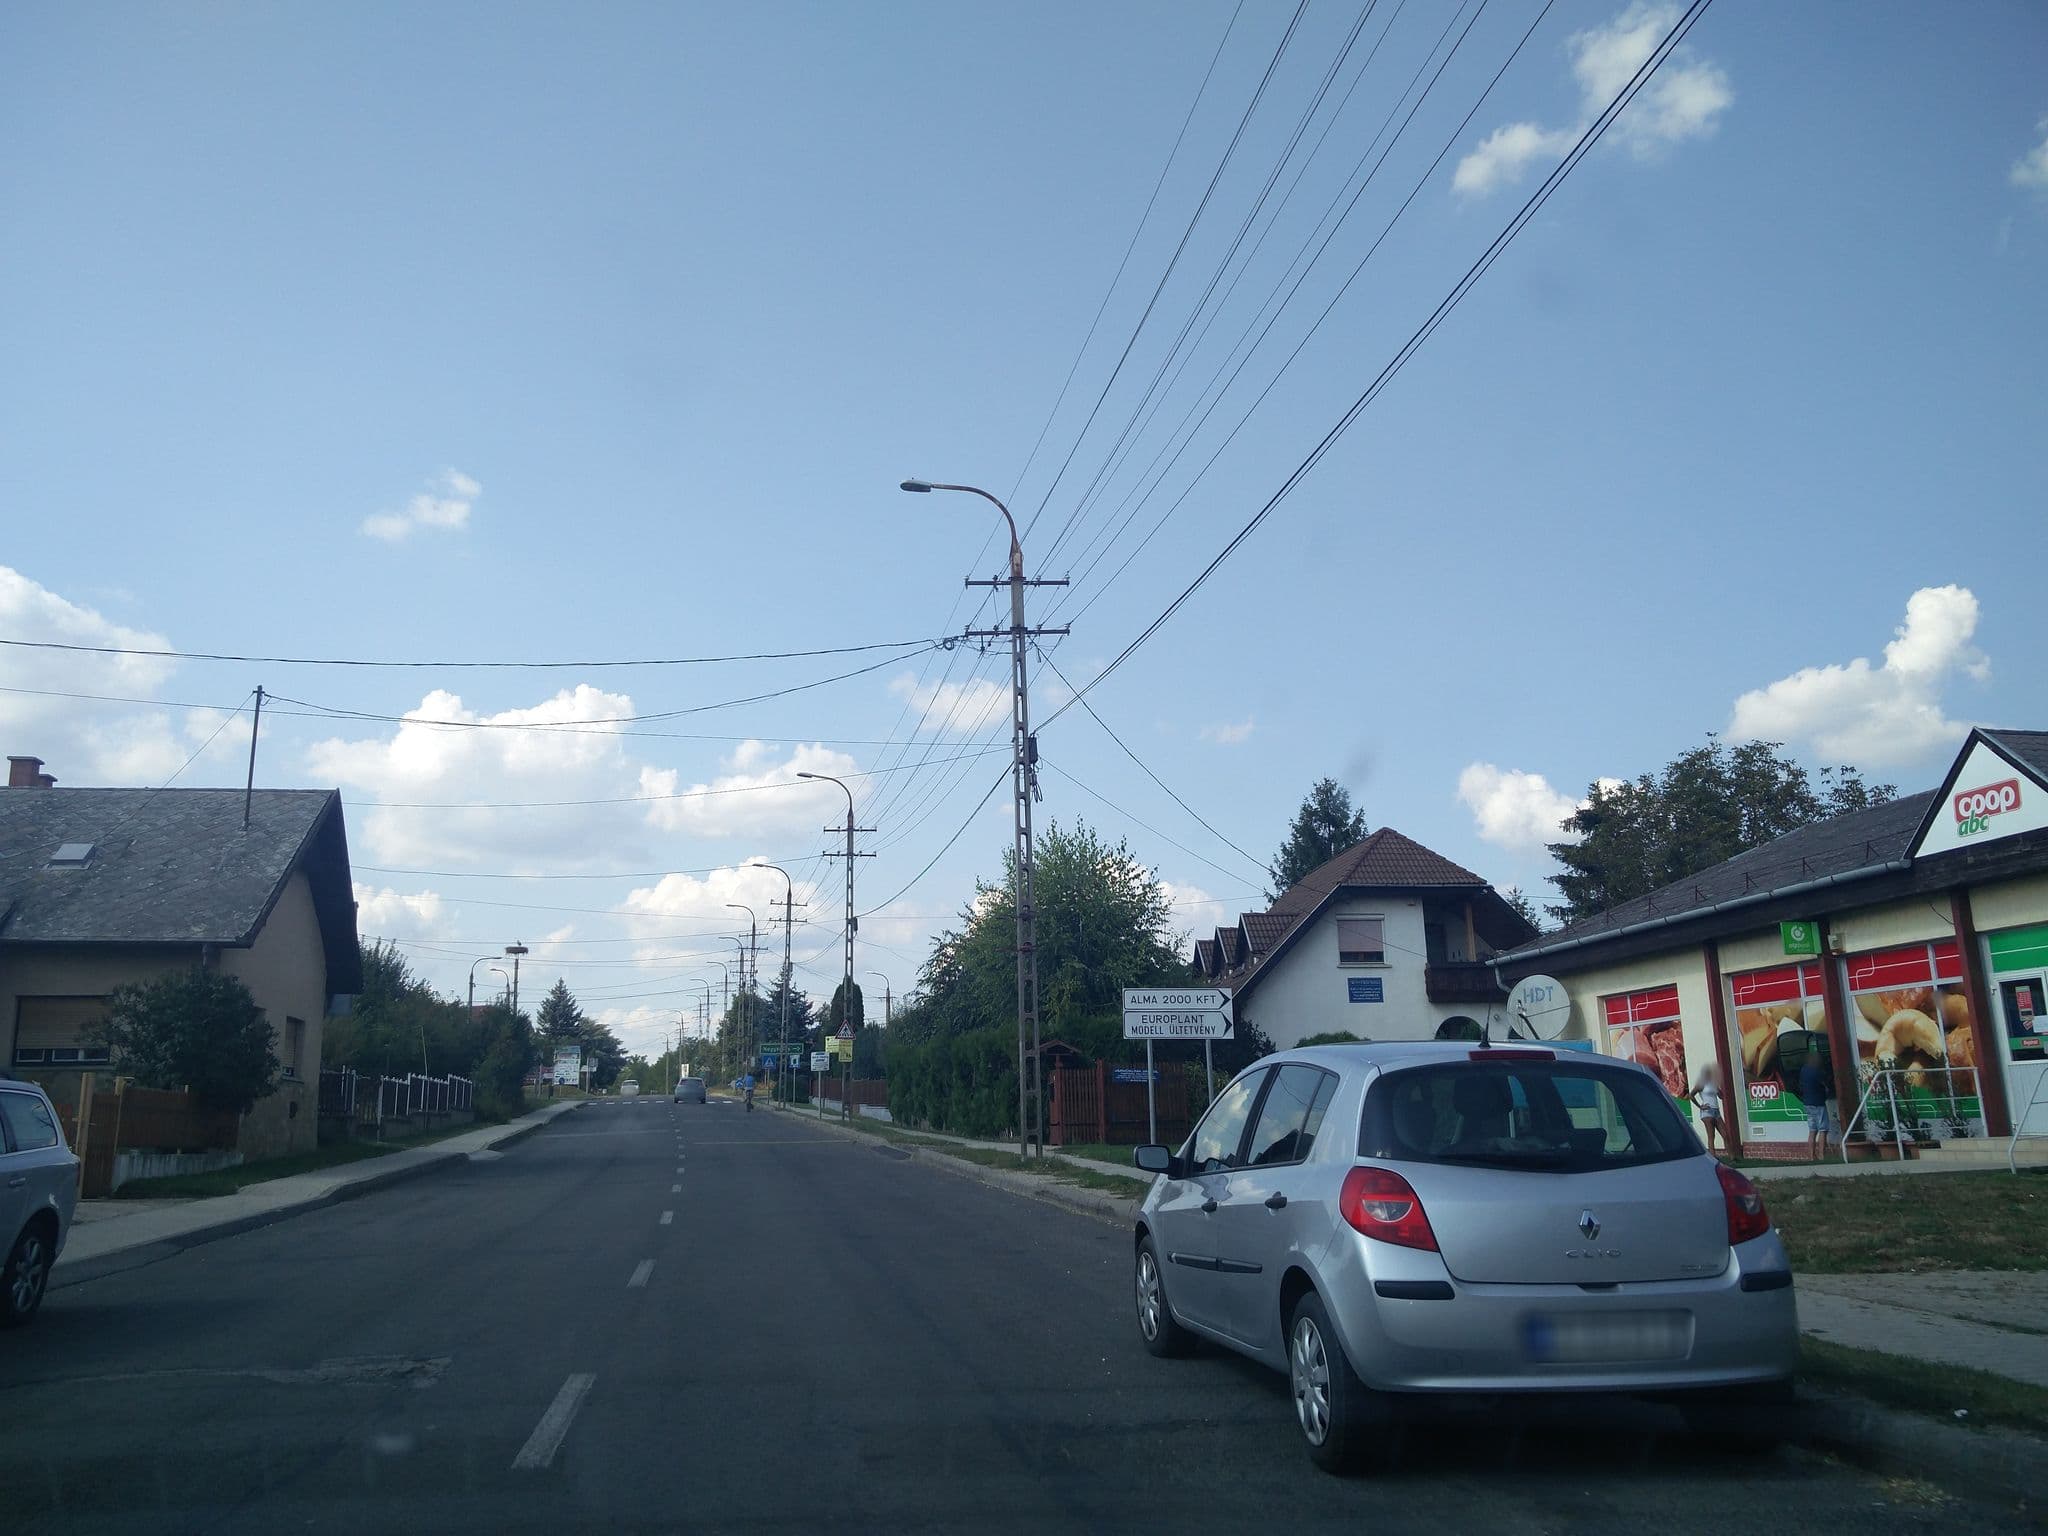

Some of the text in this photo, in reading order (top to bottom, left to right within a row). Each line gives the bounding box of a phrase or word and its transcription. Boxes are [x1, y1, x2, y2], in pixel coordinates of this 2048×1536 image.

[1958, 786, 2016, 817] coop
[1958, 809, 1989, 836] abc
[1130, 995, 1217, 1004] ALMA 2000 KFT
[1523, 986, 1553, 1003] HDT
[1141, 1014, 1205, 1024] EUROPLANT
[1131, 1026, 1164, 1035] MODELL
[1751, 1085, 1777, 1100] coop
[1565, 1249, 1622, 1258] CLIO
